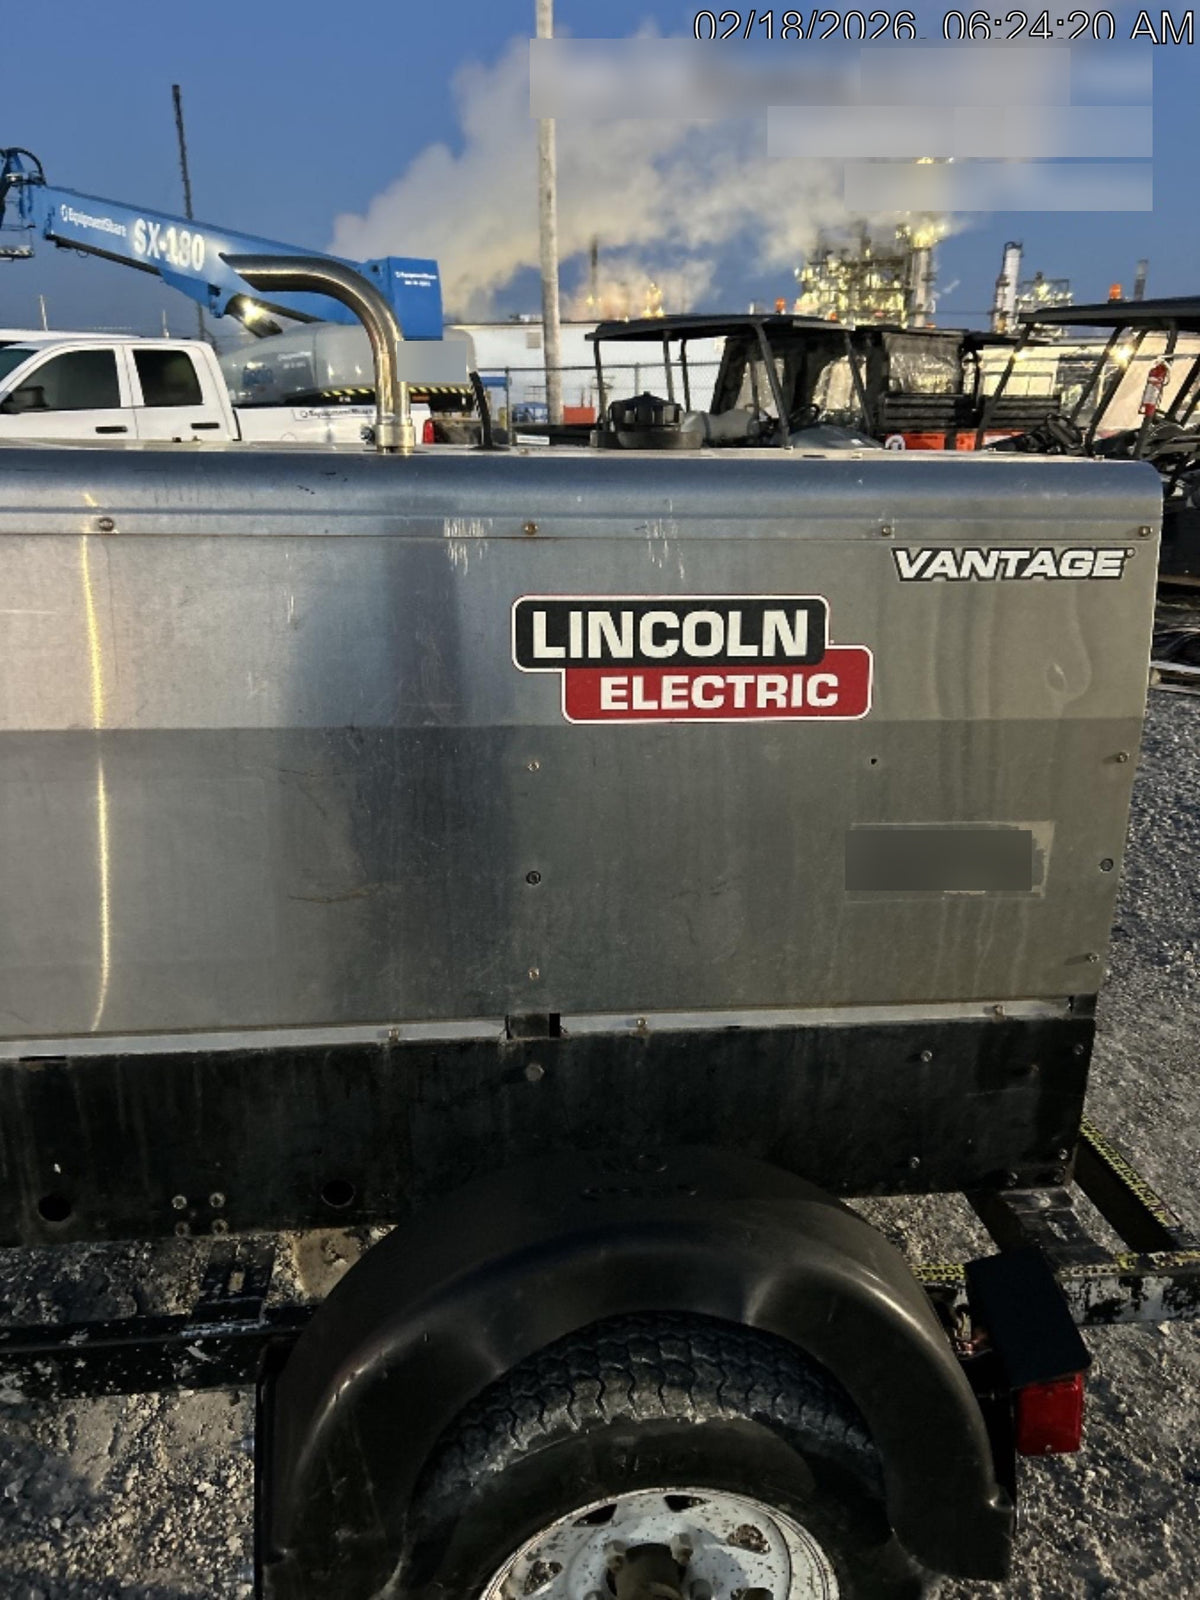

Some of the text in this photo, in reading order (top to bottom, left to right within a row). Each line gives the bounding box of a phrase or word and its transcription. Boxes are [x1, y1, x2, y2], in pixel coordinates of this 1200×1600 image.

[134, 208, 205, 271] SX-180
[532, 609, 808, 659] LINCOLN
[600, 673, 839, 710] ELECTRIC
